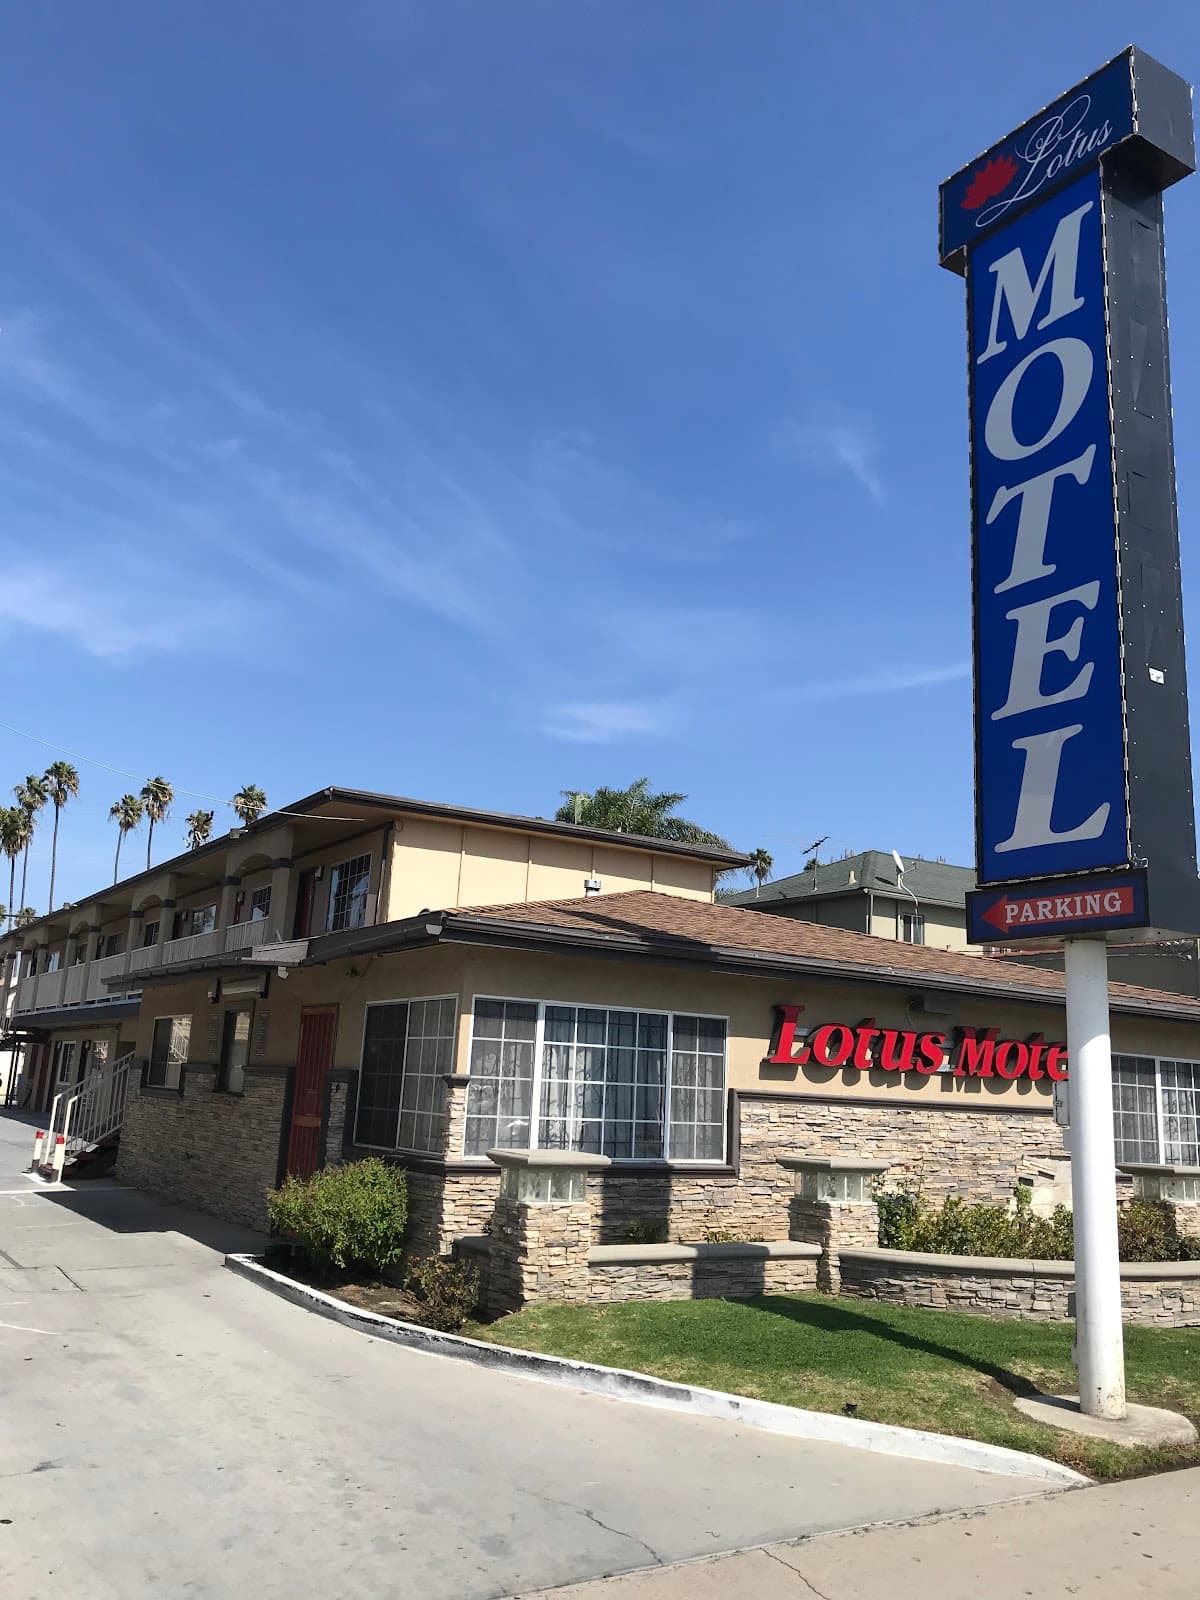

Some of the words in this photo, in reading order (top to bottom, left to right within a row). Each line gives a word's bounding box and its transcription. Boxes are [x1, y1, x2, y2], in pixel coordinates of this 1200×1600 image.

[975, 94, 1113, 228] Lotus
[976, 201, 1111, 853] MOTEL
[1004, 891, 1122, 924] PARKING
[768, 1004, 945, 1074] Lotus
[953, 1025, 1069, 1081] Mote
